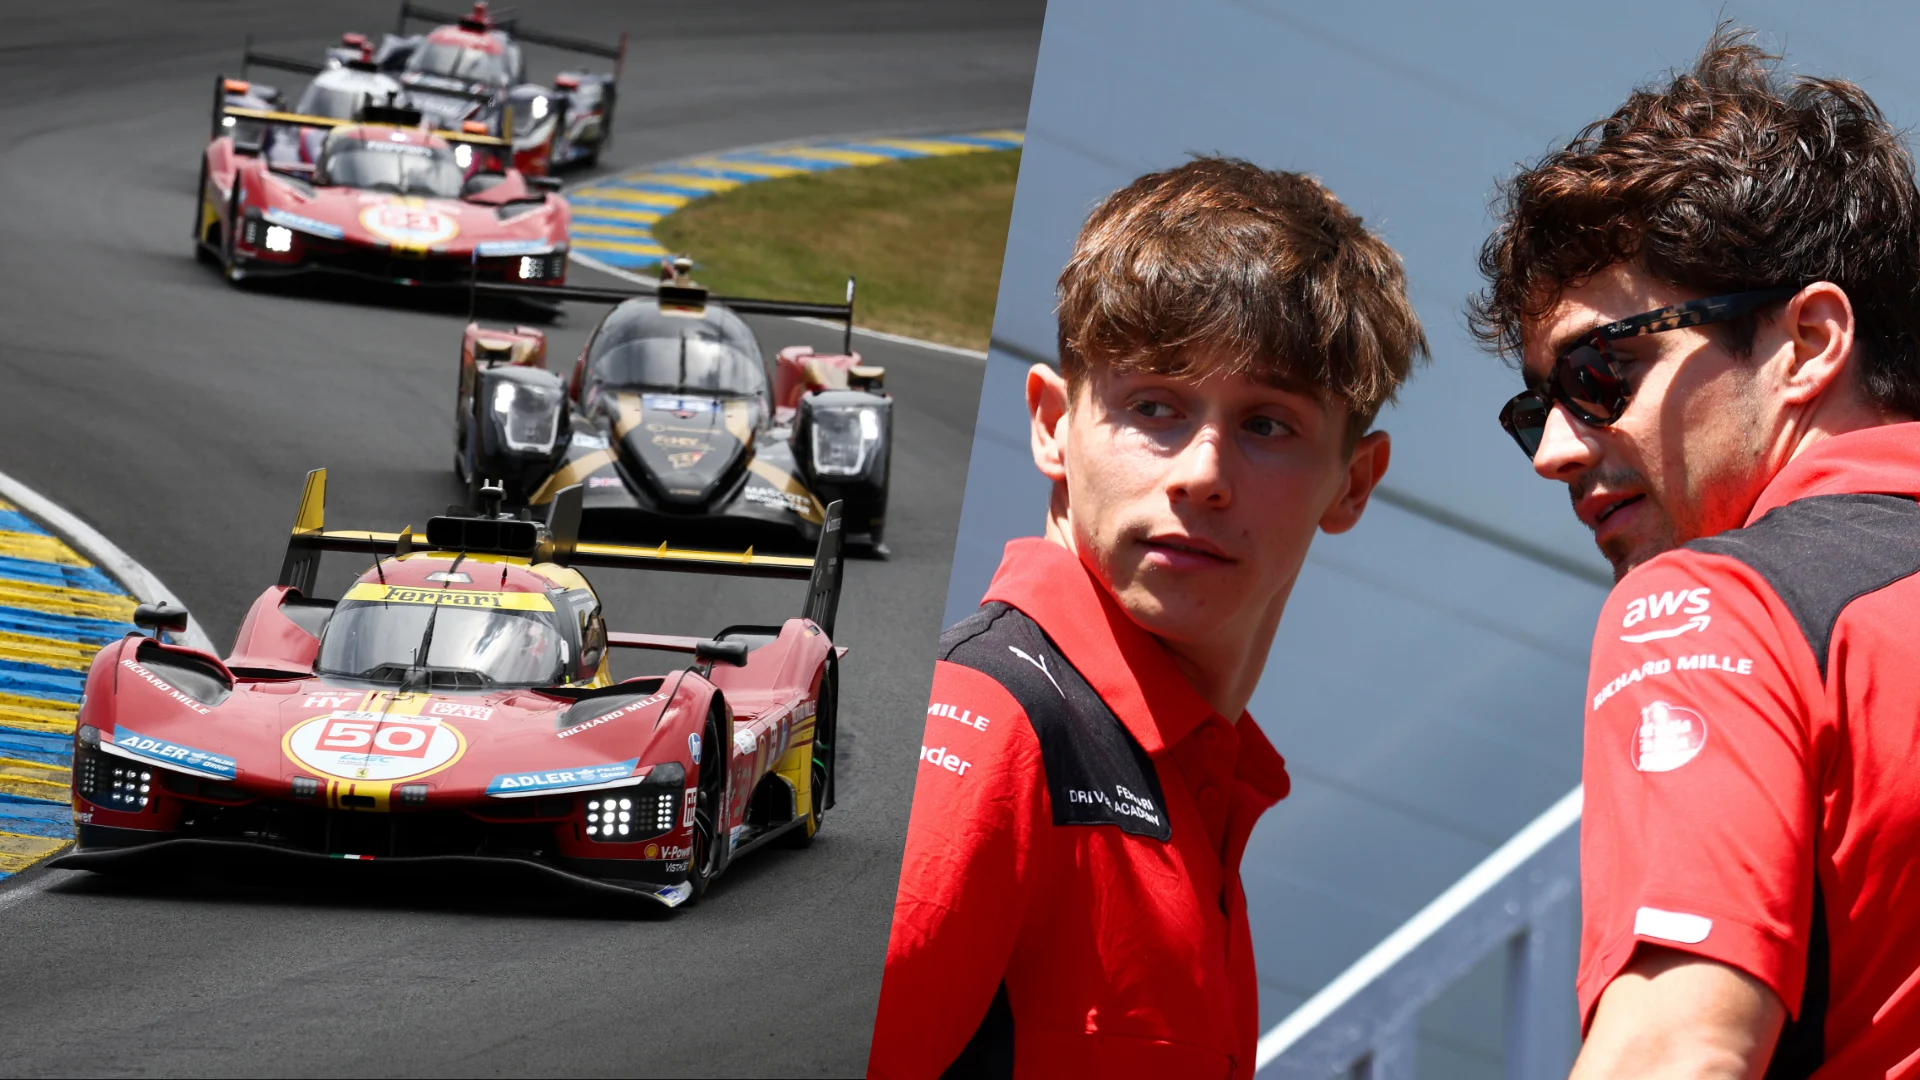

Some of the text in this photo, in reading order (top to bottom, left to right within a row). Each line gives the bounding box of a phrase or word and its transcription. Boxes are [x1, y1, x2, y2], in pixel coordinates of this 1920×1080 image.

[381, 586, 504, 607] Ferrari
[1622, 587, 1711, 628] aws
[120, 659, 211, 715] RICHARD MILLE
[1593, 654, 1754, 711] RICHARD MILLE
[302, 696, 352, 708] HY
[557, 693, 671, 739] RICHARD MILLE
[927, 703, 990, 732] MILLE
[118, 736, 190, 760] ADLER
[323, 722, 426, 752] 50
[500, 771, 576, 788] ADLER
